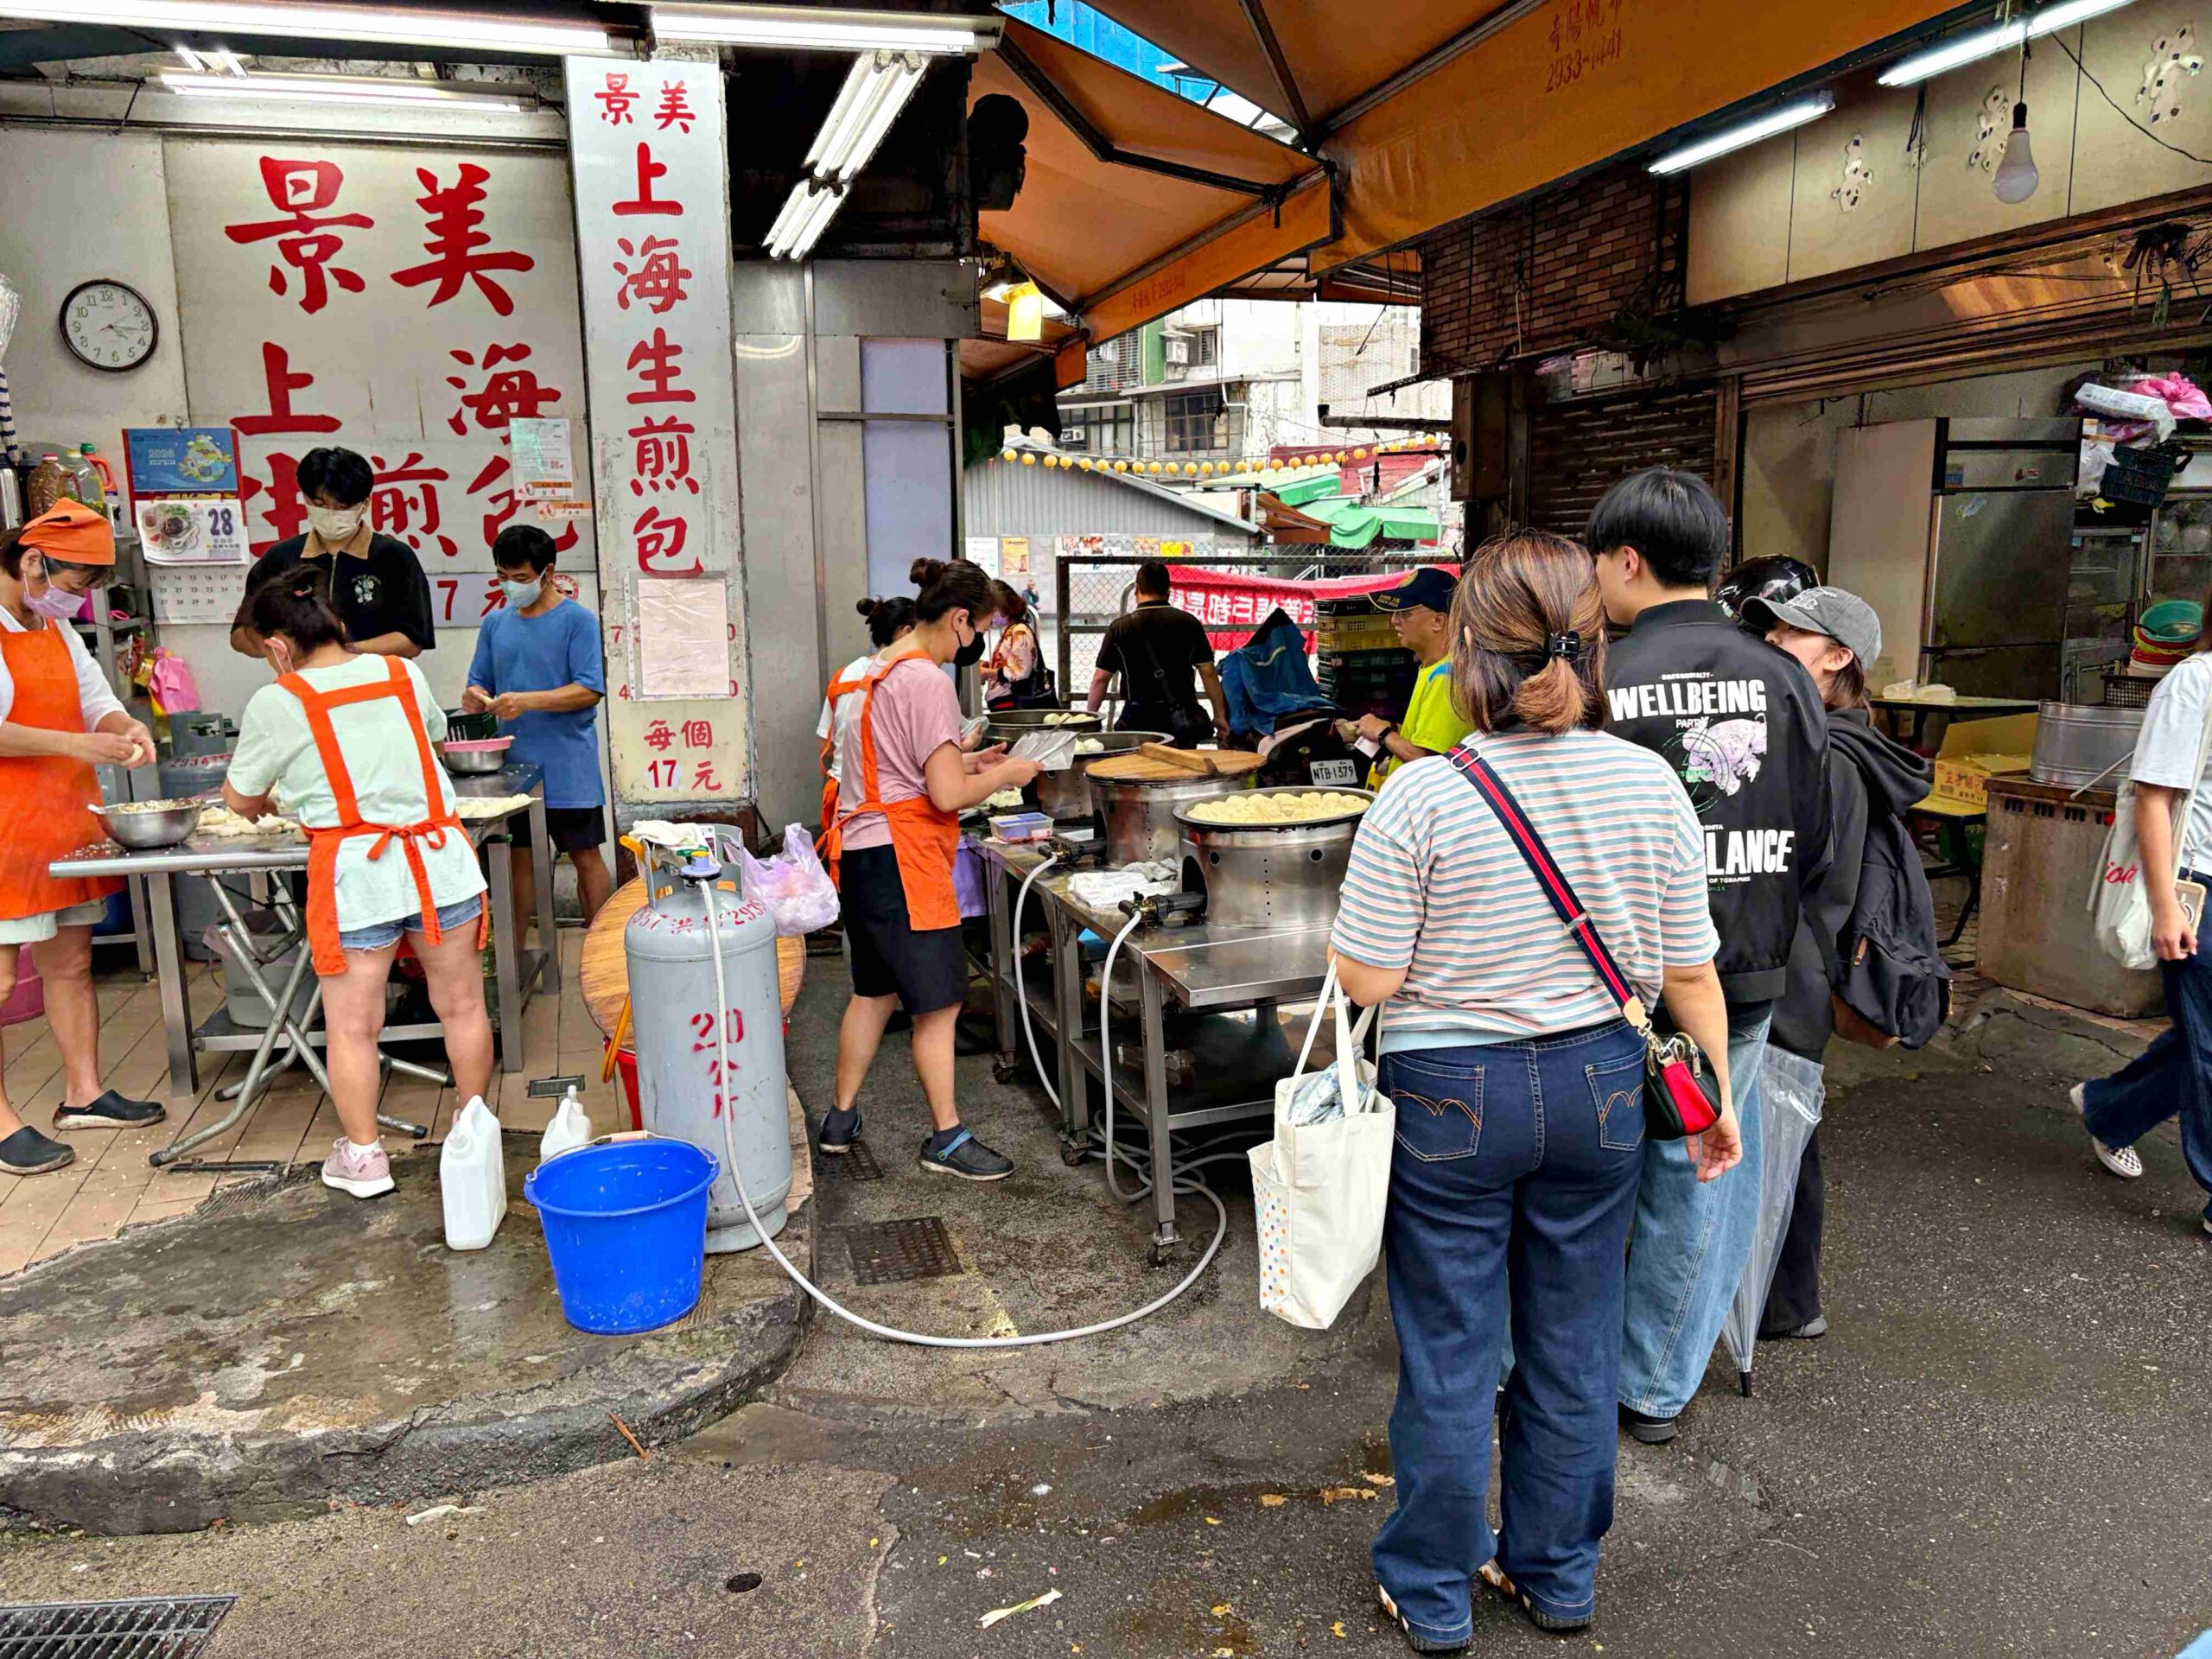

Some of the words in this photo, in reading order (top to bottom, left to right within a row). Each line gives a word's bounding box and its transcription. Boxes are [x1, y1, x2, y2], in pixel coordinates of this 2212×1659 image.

[594, 73, 696, 134] 景美
[225, 156, 535, 316] 景美
[612, 142, 704, 579] 上海生煎包
[230, 341, 562, 444] 上海
[208, 507, 233, 536] 28
[1607, 679, 1767, 721] WELLBEING
[644, 719, 714, 751] 每個
[1313, 766, 1354, 780] NTB-1379
[1706, 830, 1796, 875] LANCE
[690, 1008, 744, 1053] 20
